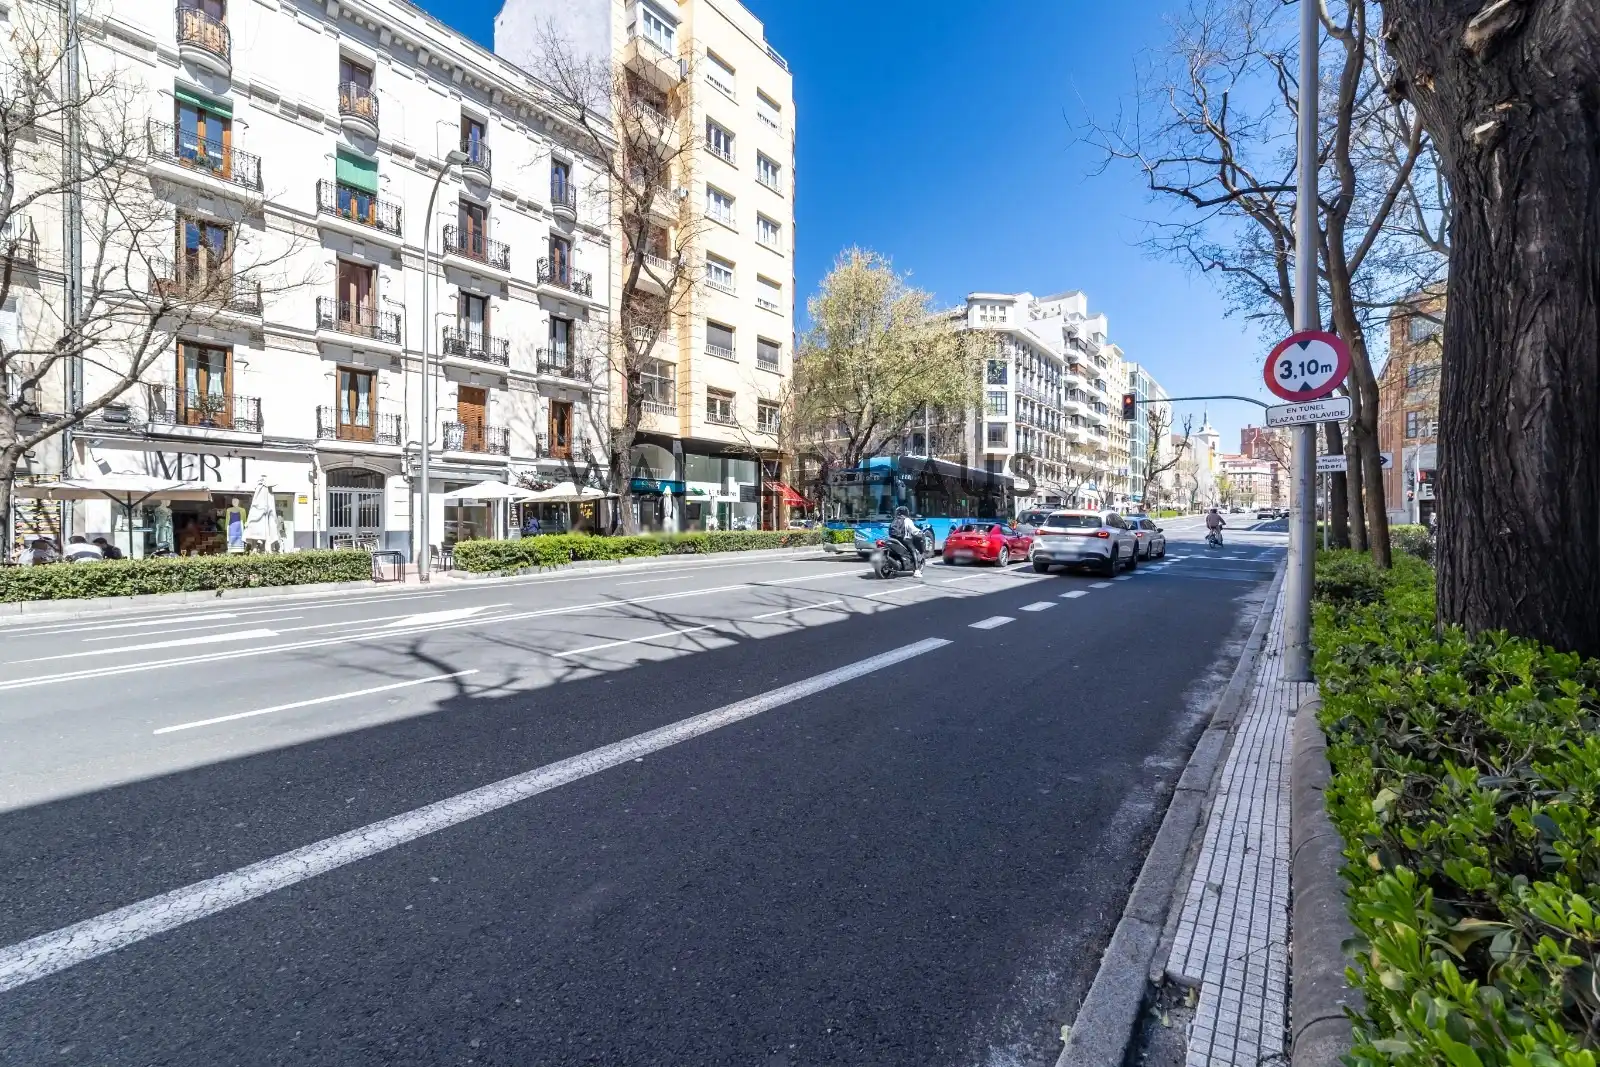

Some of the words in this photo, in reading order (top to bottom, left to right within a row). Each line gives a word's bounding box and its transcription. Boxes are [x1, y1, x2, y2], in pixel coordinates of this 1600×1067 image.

[1280, 359, 1332, 380] 3,10m
[1299, 404, 1325, 412] TÚNEL
[1270, 416, 1295, 425] PLAZA
[1309, 410, 1346, 419] OLAVIDE
